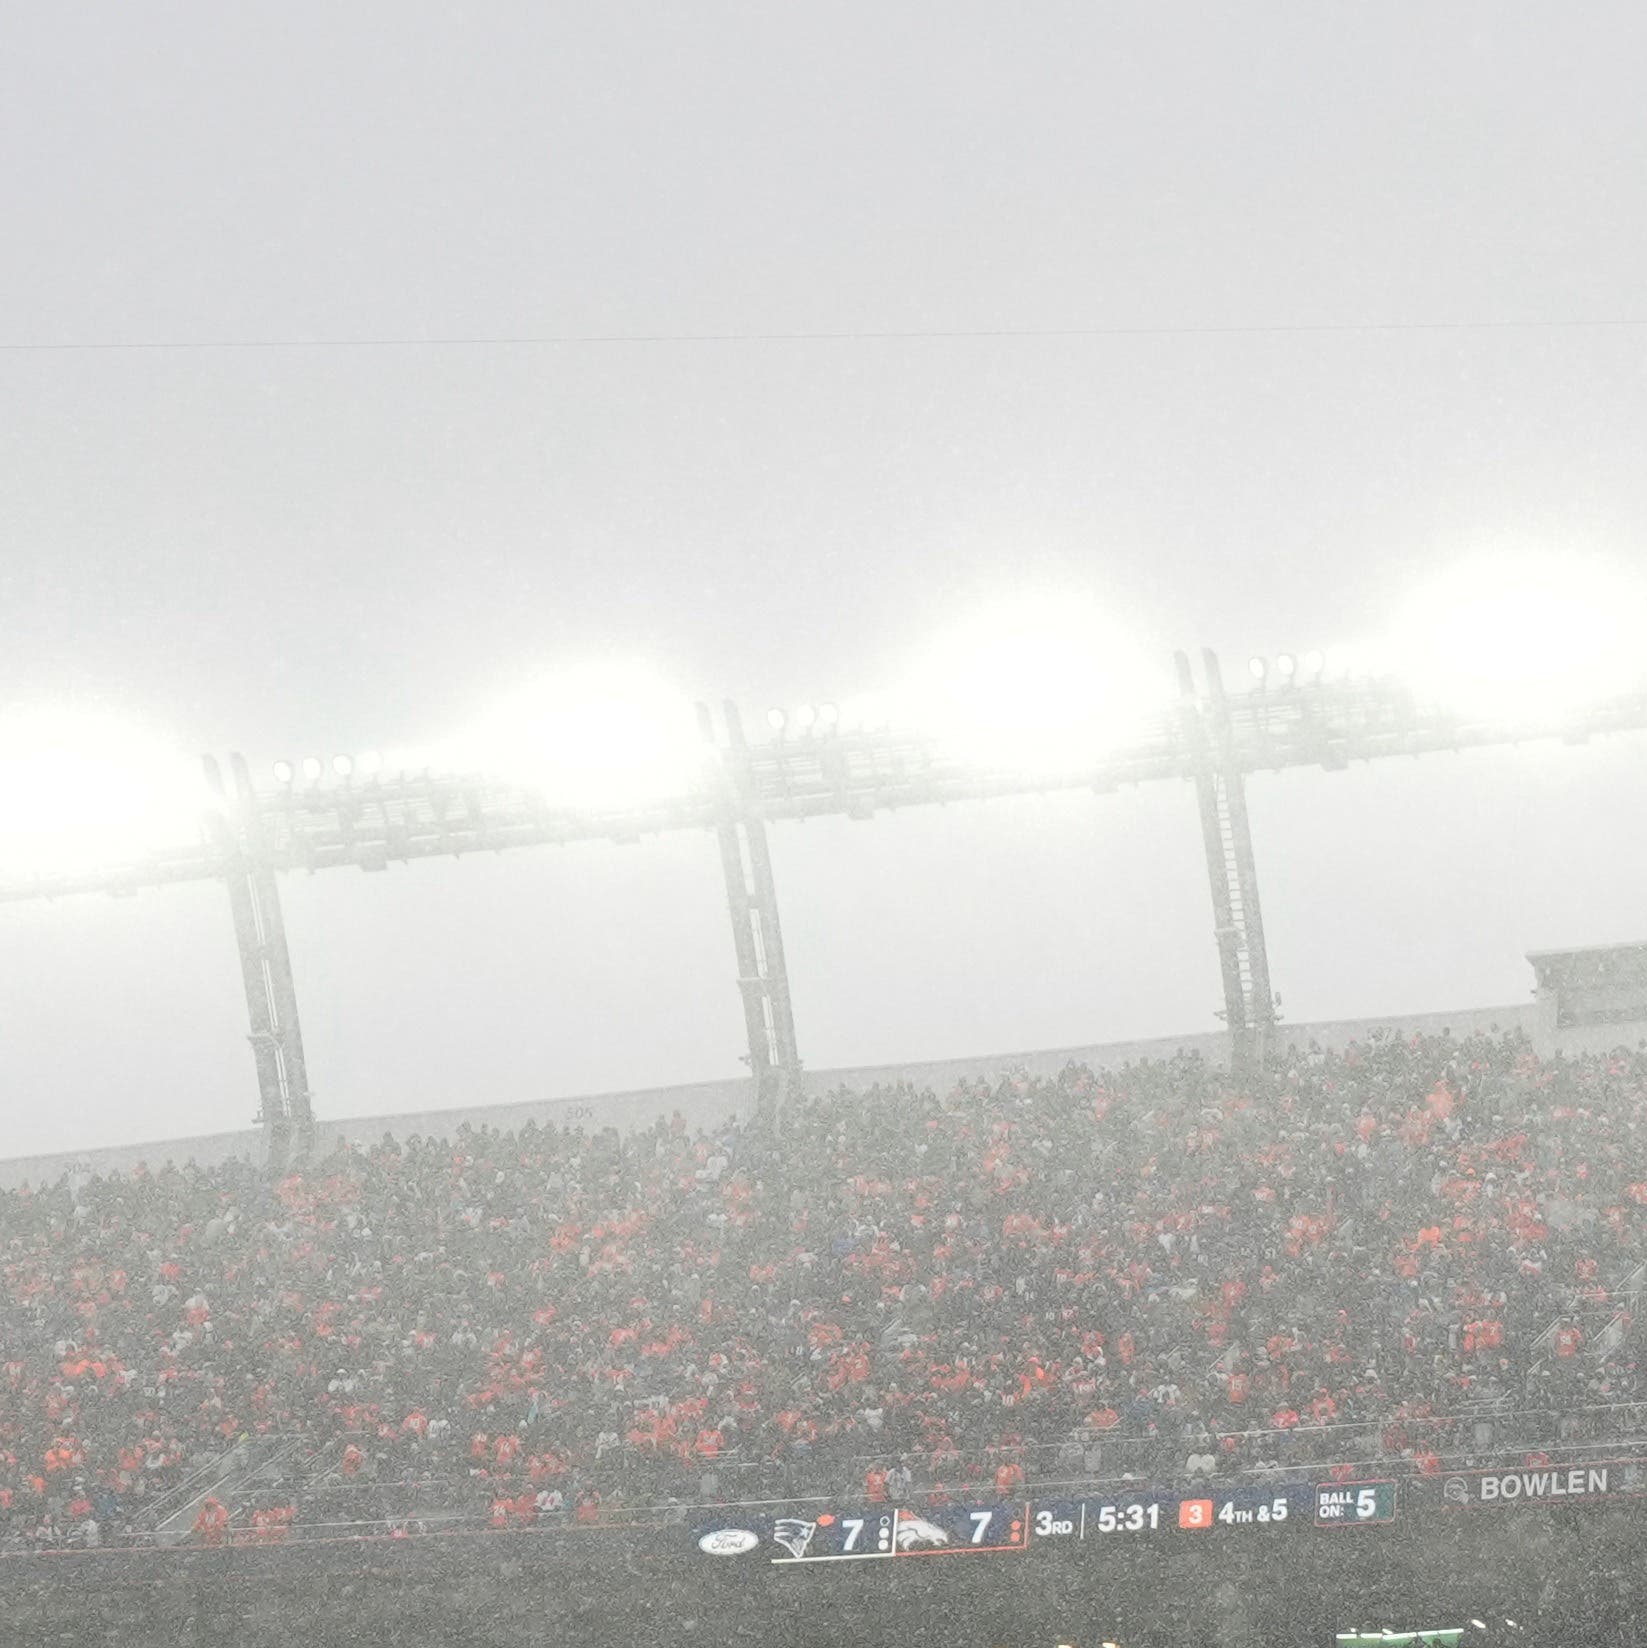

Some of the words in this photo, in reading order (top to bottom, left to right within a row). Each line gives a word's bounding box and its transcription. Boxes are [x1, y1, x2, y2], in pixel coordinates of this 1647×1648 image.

[1319, 1491, 1353, 1504] BALL
[1481, 1469, 1608, 1499] BOWLEN
[1188, 1505, 1203, 1524] 3
[1218, 1501, 1253, 1524] 4TH
[1319, 1505, 1344, 1519] ON:
[1356, 1489, 1376, 1518] 5
[969, 1512, 992, 1543] 7
[1035, 1510, 1073, 1536] 3RD
[1098, 1503, 1159, 1532] 5:31
[842, 1520, 864, 1550] 7
